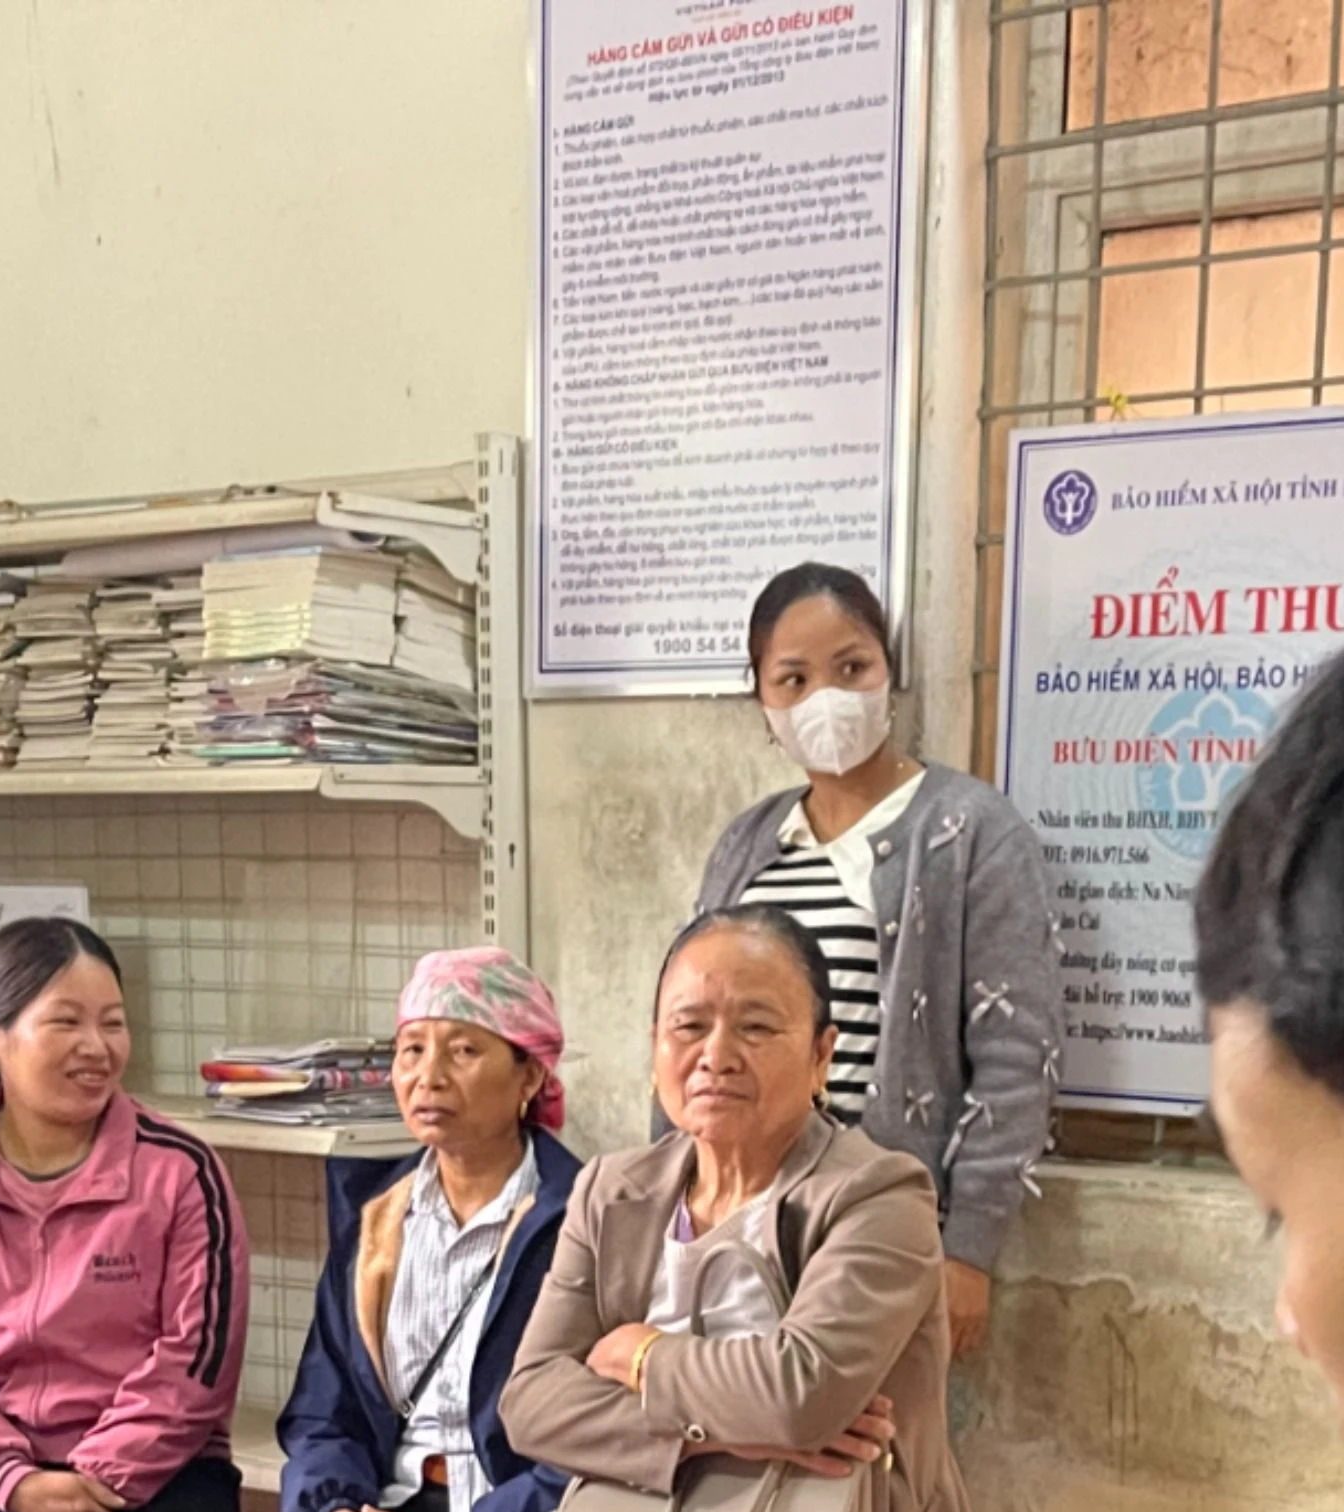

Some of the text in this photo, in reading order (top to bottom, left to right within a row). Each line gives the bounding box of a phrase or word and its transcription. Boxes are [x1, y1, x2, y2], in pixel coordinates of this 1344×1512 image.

[697, 25, 717, 48] VÀ
[752, 15, 774, 38] CÓ
[818, 1, 853, 27] KIỆN
[1111, 485, 1151, 511] BẢO
[1155, 479, 1207, 507] HIỂM
[1212, 481, 1238, 504] XÃ
[1245, 477, 1282, 505] HỘI
[1089, 566, 1230, 640] ĐIỂM
[654, 635, 740, 654] 1900 54 54
[1036, 662, 1080, 693] BẢO
[1087, 658, 1140, 692] HIỂM
[1147, 662, 1176, 691] XÃ
[1184, 660, 1228, 693] HỘI,
[1236, 657, 1285, 690] BẢO
[1052, 735, 1106, 765] BƯU
[1114, 733, 1178, 768] ĐIỆN
